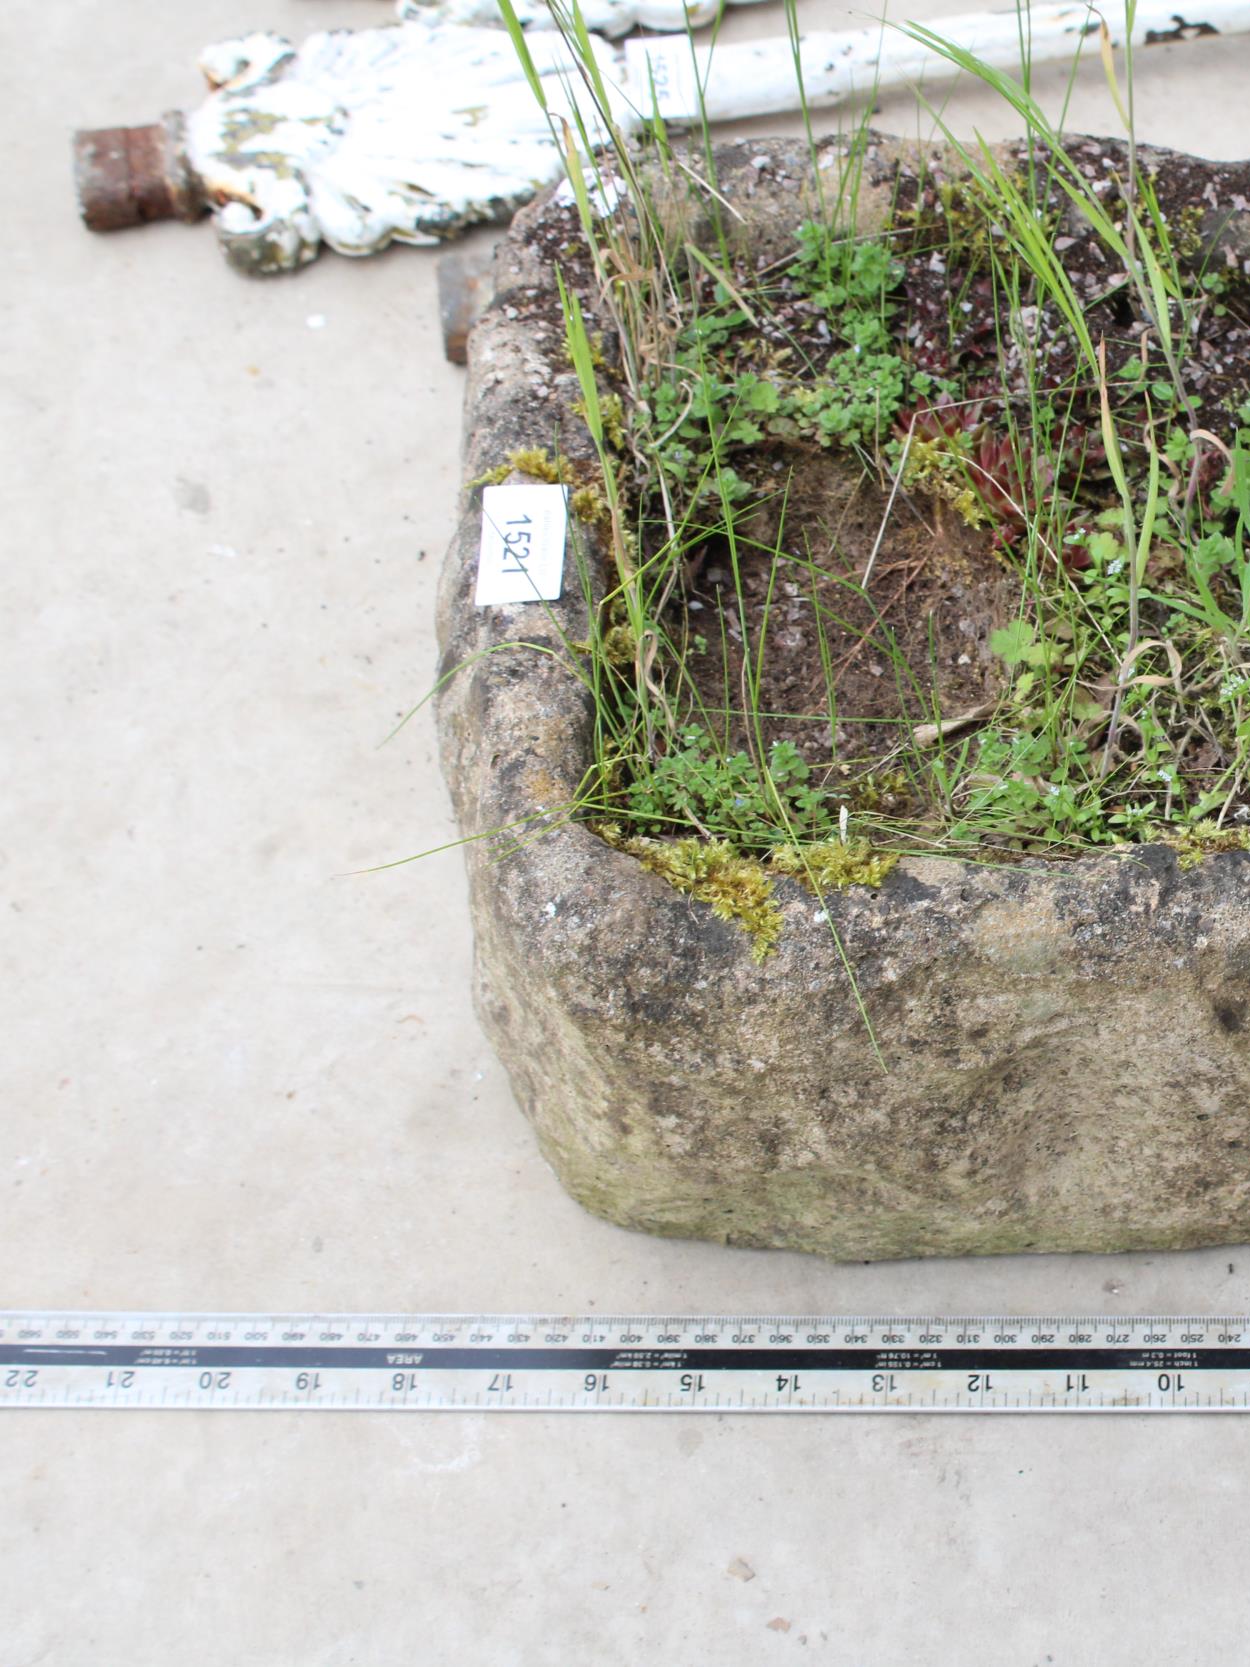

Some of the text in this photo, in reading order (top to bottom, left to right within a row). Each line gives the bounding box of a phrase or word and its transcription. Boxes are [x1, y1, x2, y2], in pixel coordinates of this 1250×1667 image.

[502, 514, 532, 573] 1521
[387, 1354, 423, 1364] AREA
[5, 1370, 38, 1387] 22
[106, 1371, 134, 1388] 21
[199, 1372, 231, 1389] 20
[296, 1373, 321, 1390] 19
[392, 1374, 418, 1390] 18
[488, 1374, 513, 1391] 17
[584, 1374, 609, 1391] 16
[680, 1375, 705, 1391] 15
[776, 1375, 800, 1391] 14
[872, 1375, 896, 1391] 13
[968, 1375, 992, 1391] 12
[1066, 1374, 1089, 1391] 11
[1158, 1374, 1184, 1391] 10
